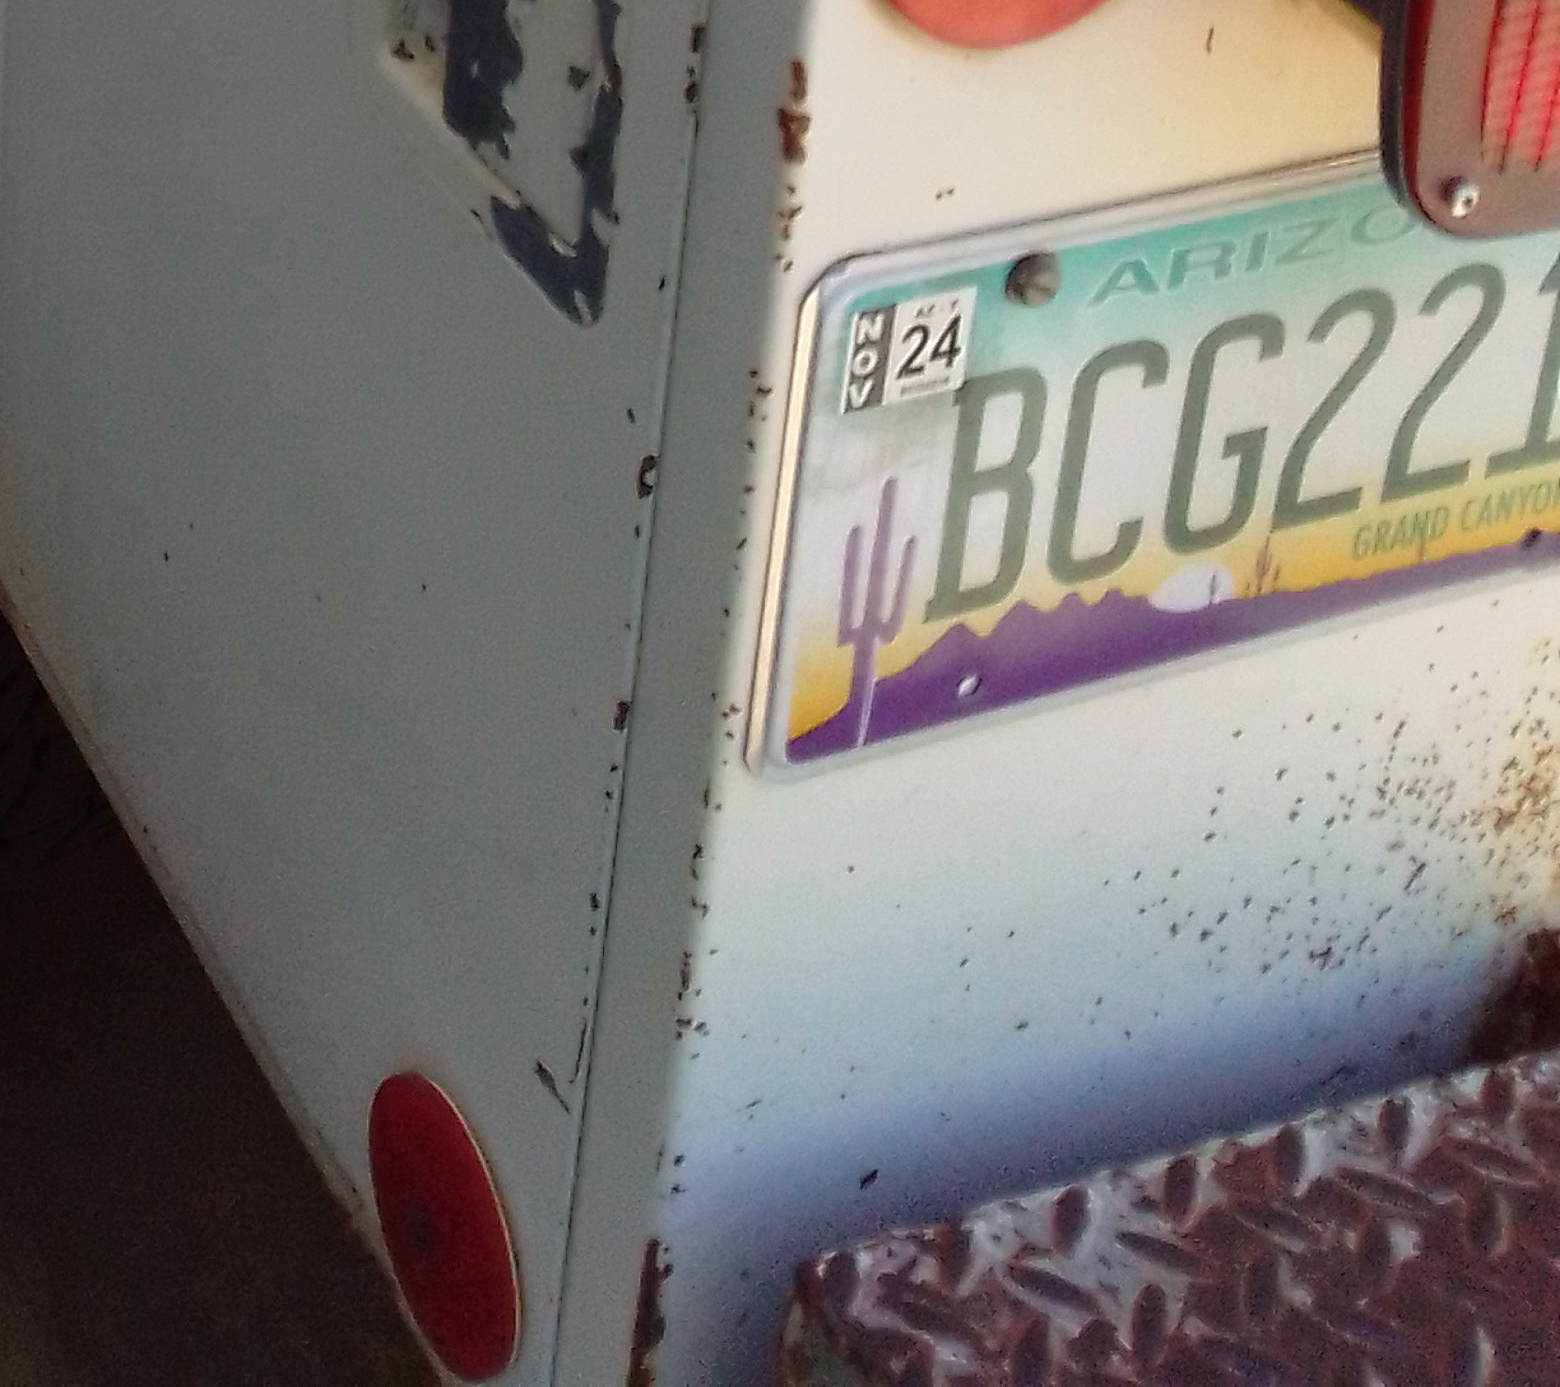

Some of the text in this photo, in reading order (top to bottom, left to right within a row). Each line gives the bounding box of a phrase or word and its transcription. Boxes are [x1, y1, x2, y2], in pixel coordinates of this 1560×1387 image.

[1085, 203, 1424, 307] ARIZO
[848, 312, 886, 409] NOV
[895, 314, 962, 381] 24
[923, 251, 1560, 624] BCG221
[1353, 506, 1450, 558] GRAND
